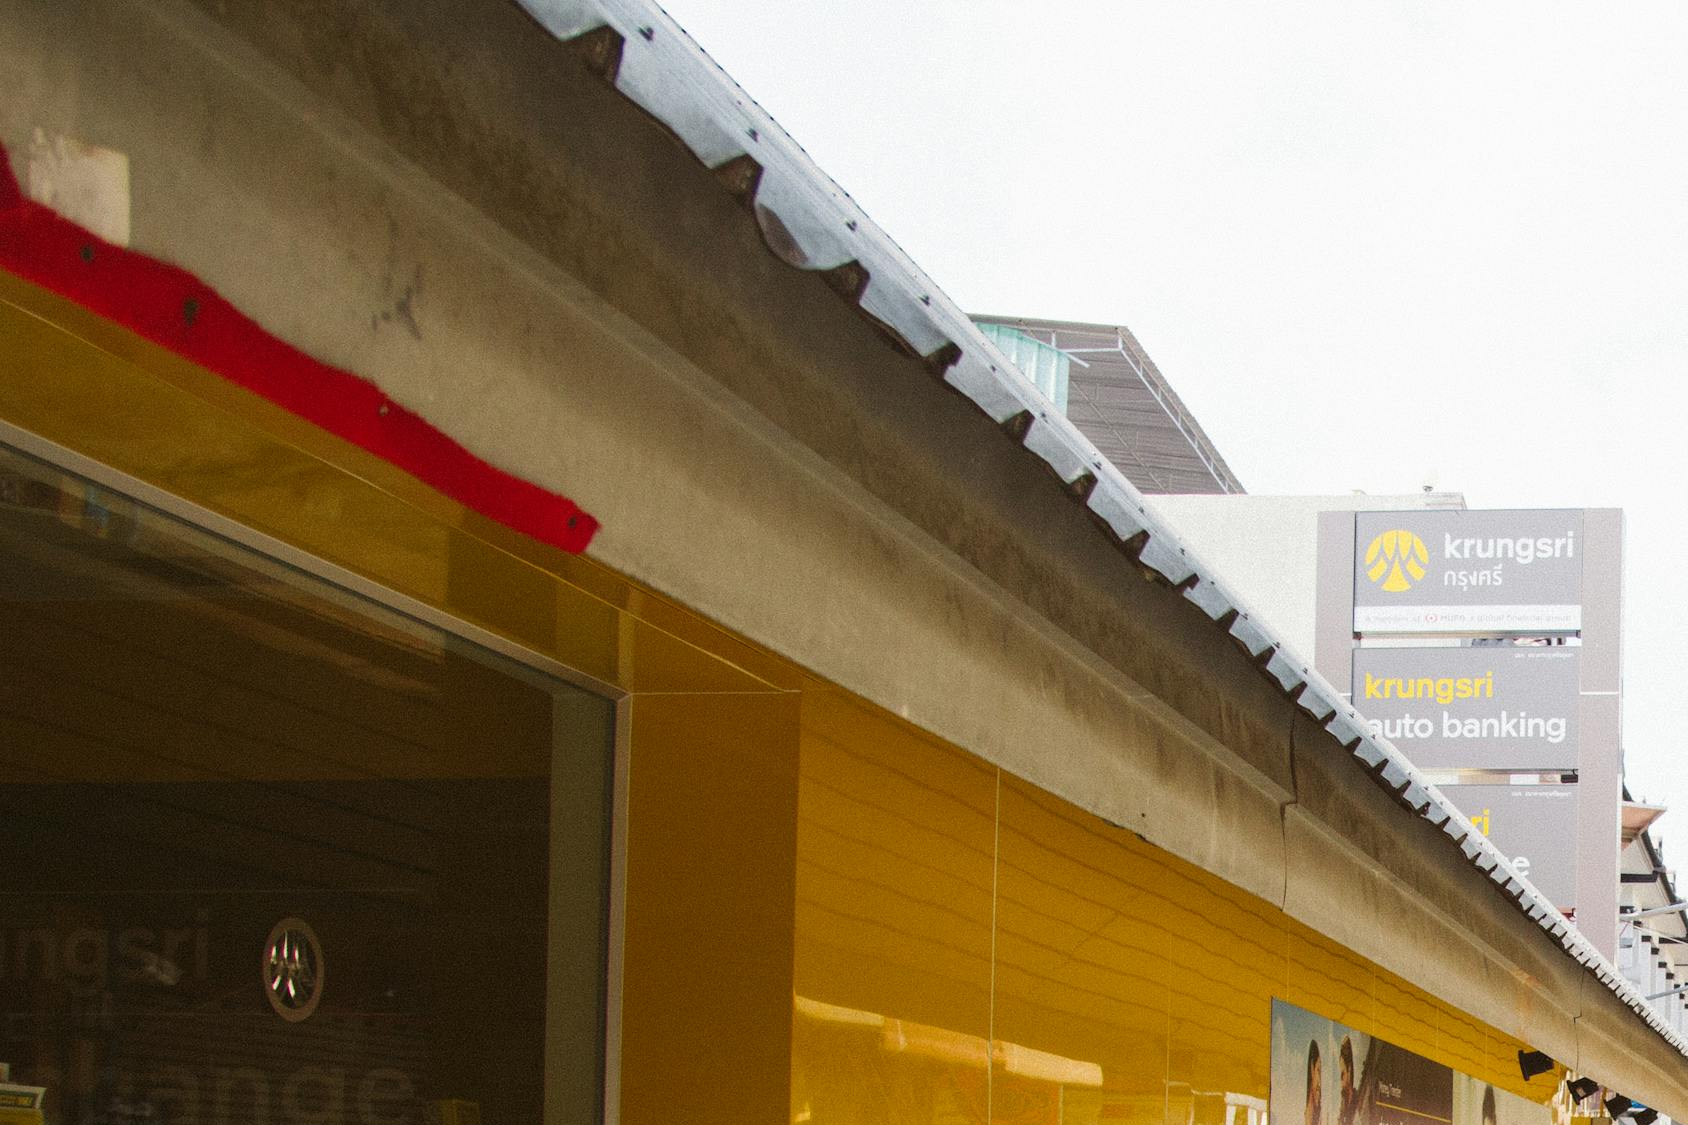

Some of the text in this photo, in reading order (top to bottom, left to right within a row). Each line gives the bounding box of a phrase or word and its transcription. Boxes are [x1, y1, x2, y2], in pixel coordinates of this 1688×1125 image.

[1444, 531, 1574, 564] krungsri
[1443, 563, 1503, 592] กรุงศรี
[1364, 671, 1493, 704] krungsri
[1368, 711, 1567, 744] auto banking
